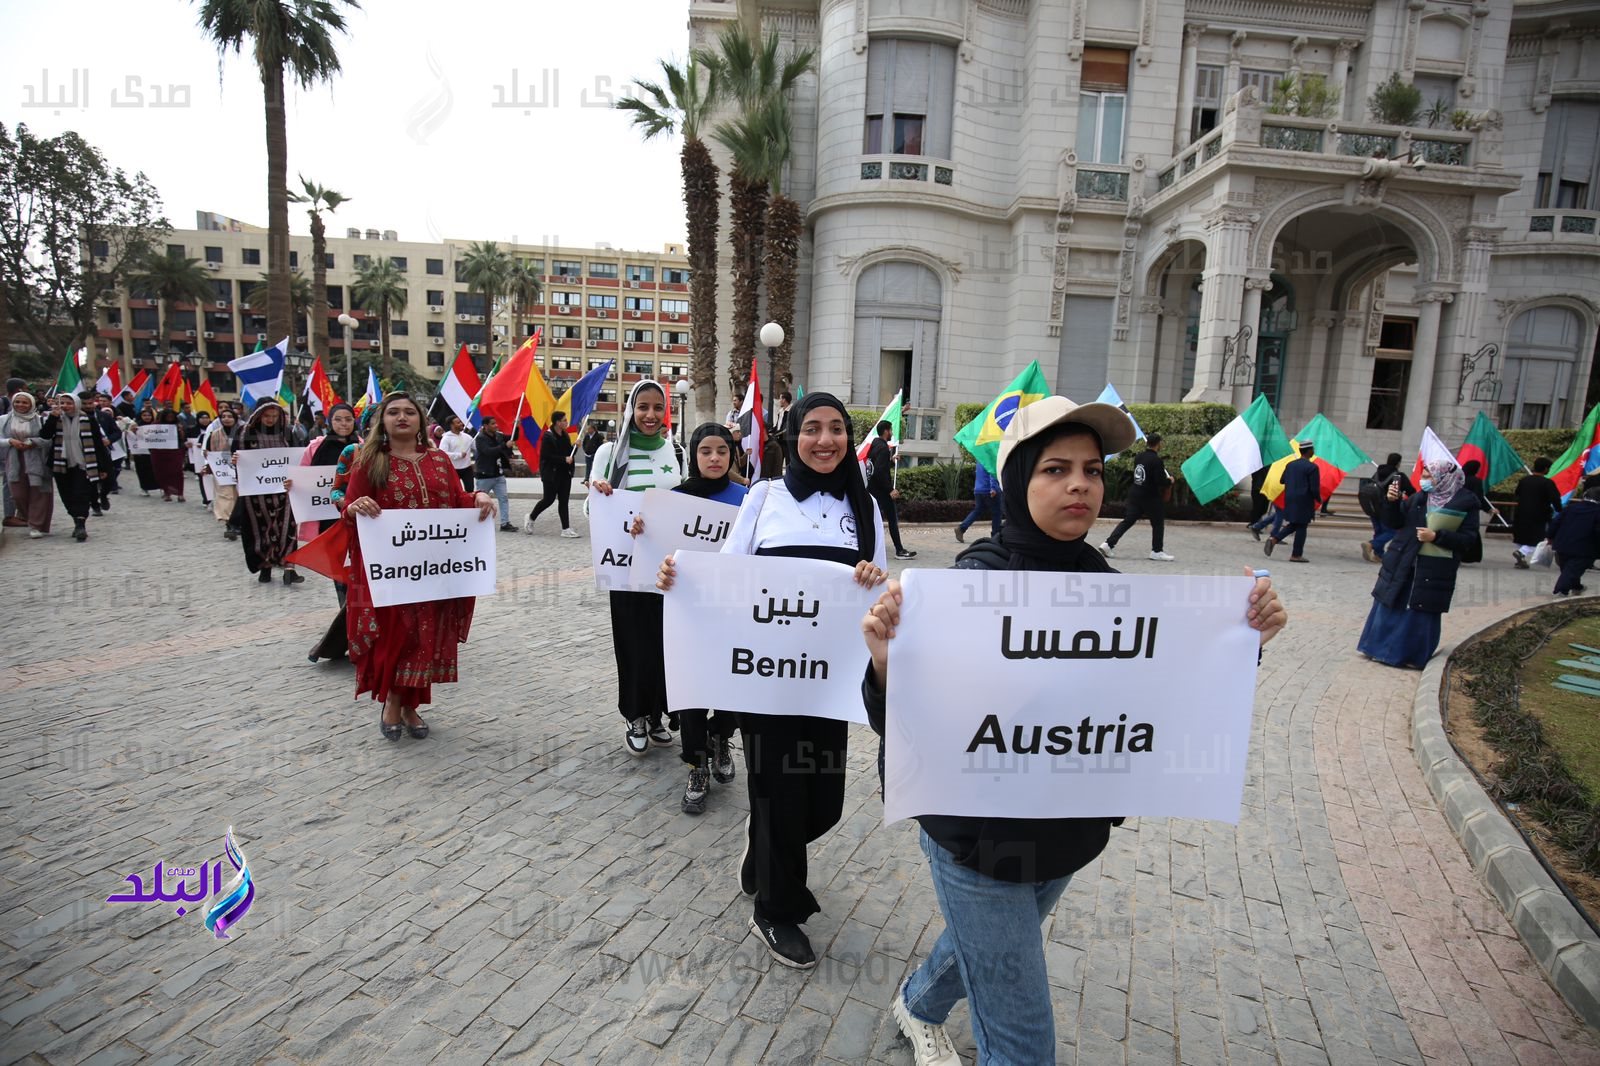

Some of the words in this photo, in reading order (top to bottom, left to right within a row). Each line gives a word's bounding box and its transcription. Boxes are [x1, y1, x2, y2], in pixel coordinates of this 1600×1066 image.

[261, 456, 290, 469] اليمن
[256, 475, 287, 485] Yeme
[392, 521, 468, 547] بنجلادش
[682, 515, 731, 543] ازيل
[369, 556, 487, 581] Bangladesh
[752, 588, 820, 627] بنين
[1001, 615, 1159, 660] النمسا
[731, 647, 829, 680] Benin
[965, 713, 1154, 756] Austria
